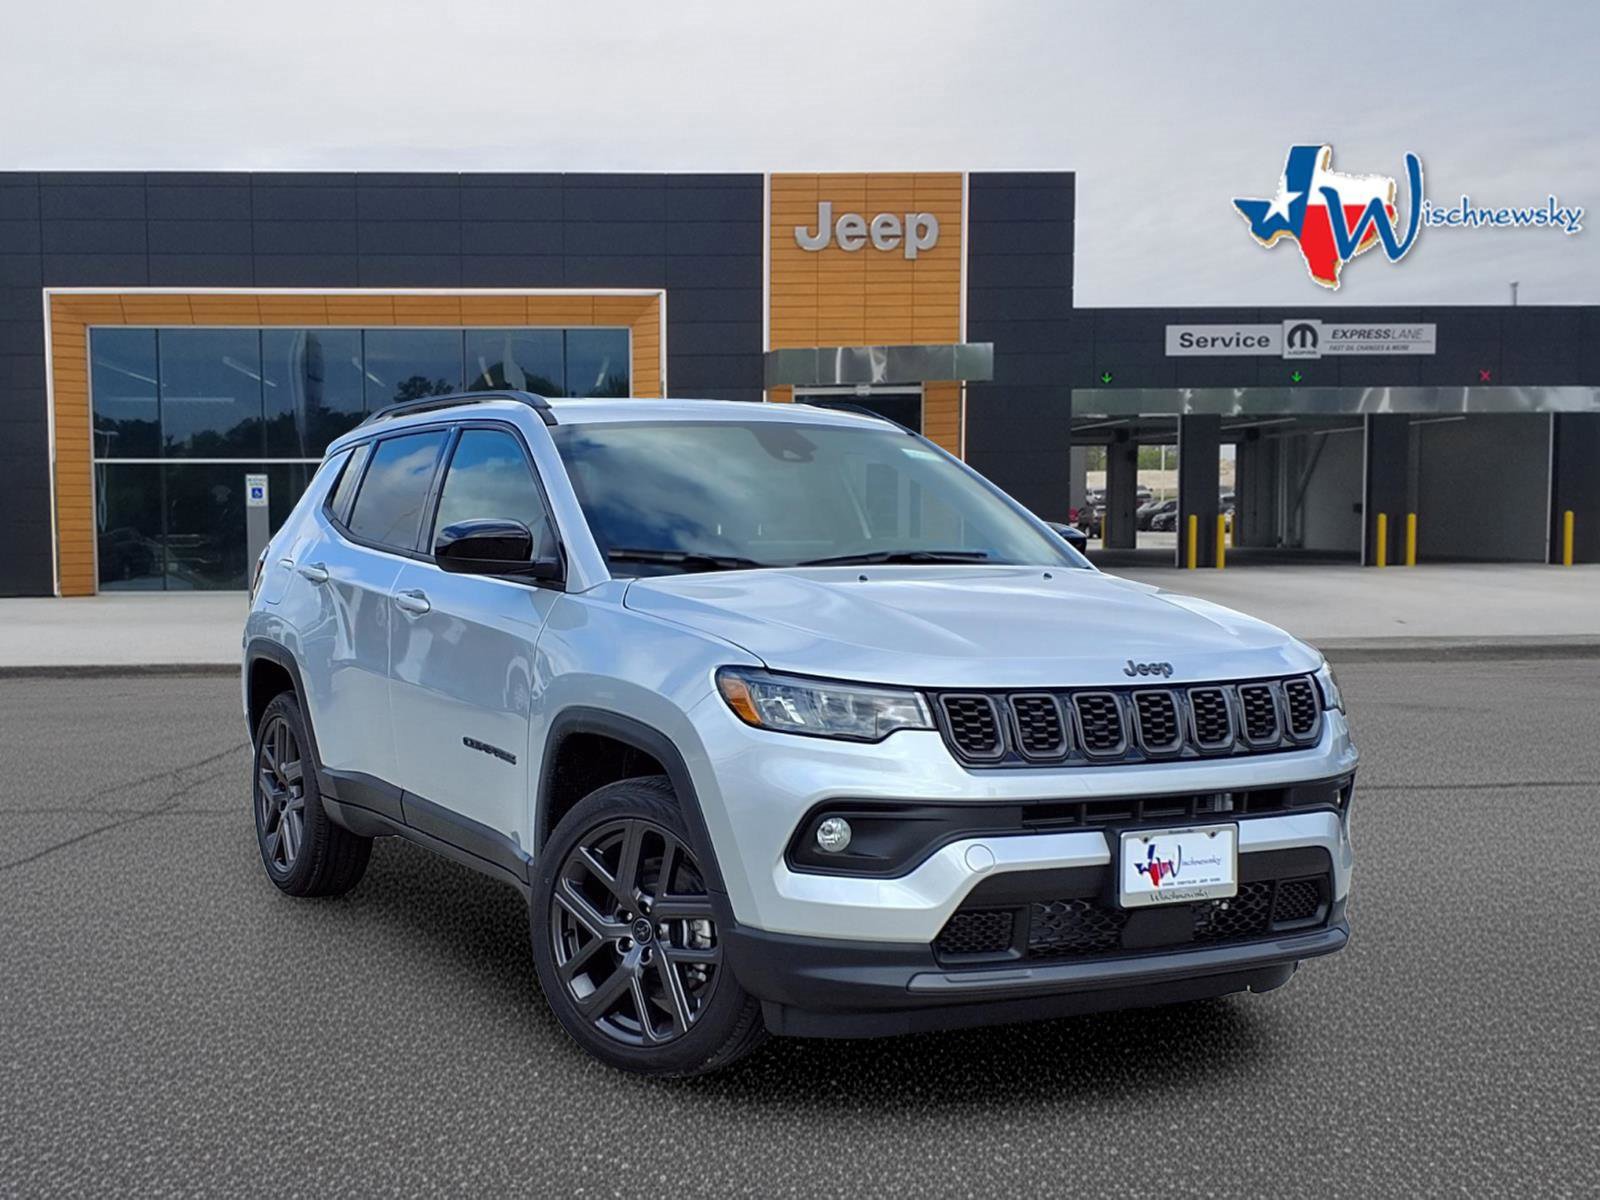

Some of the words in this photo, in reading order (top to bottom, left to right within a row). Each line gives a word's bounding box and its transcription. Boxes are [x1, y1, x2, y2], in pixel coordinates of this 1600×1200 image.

[795, 201, 939, 260] Jeep
[1179, 332, 1271, 348] Service
[1123, 659, 1173, 678] Jeep
